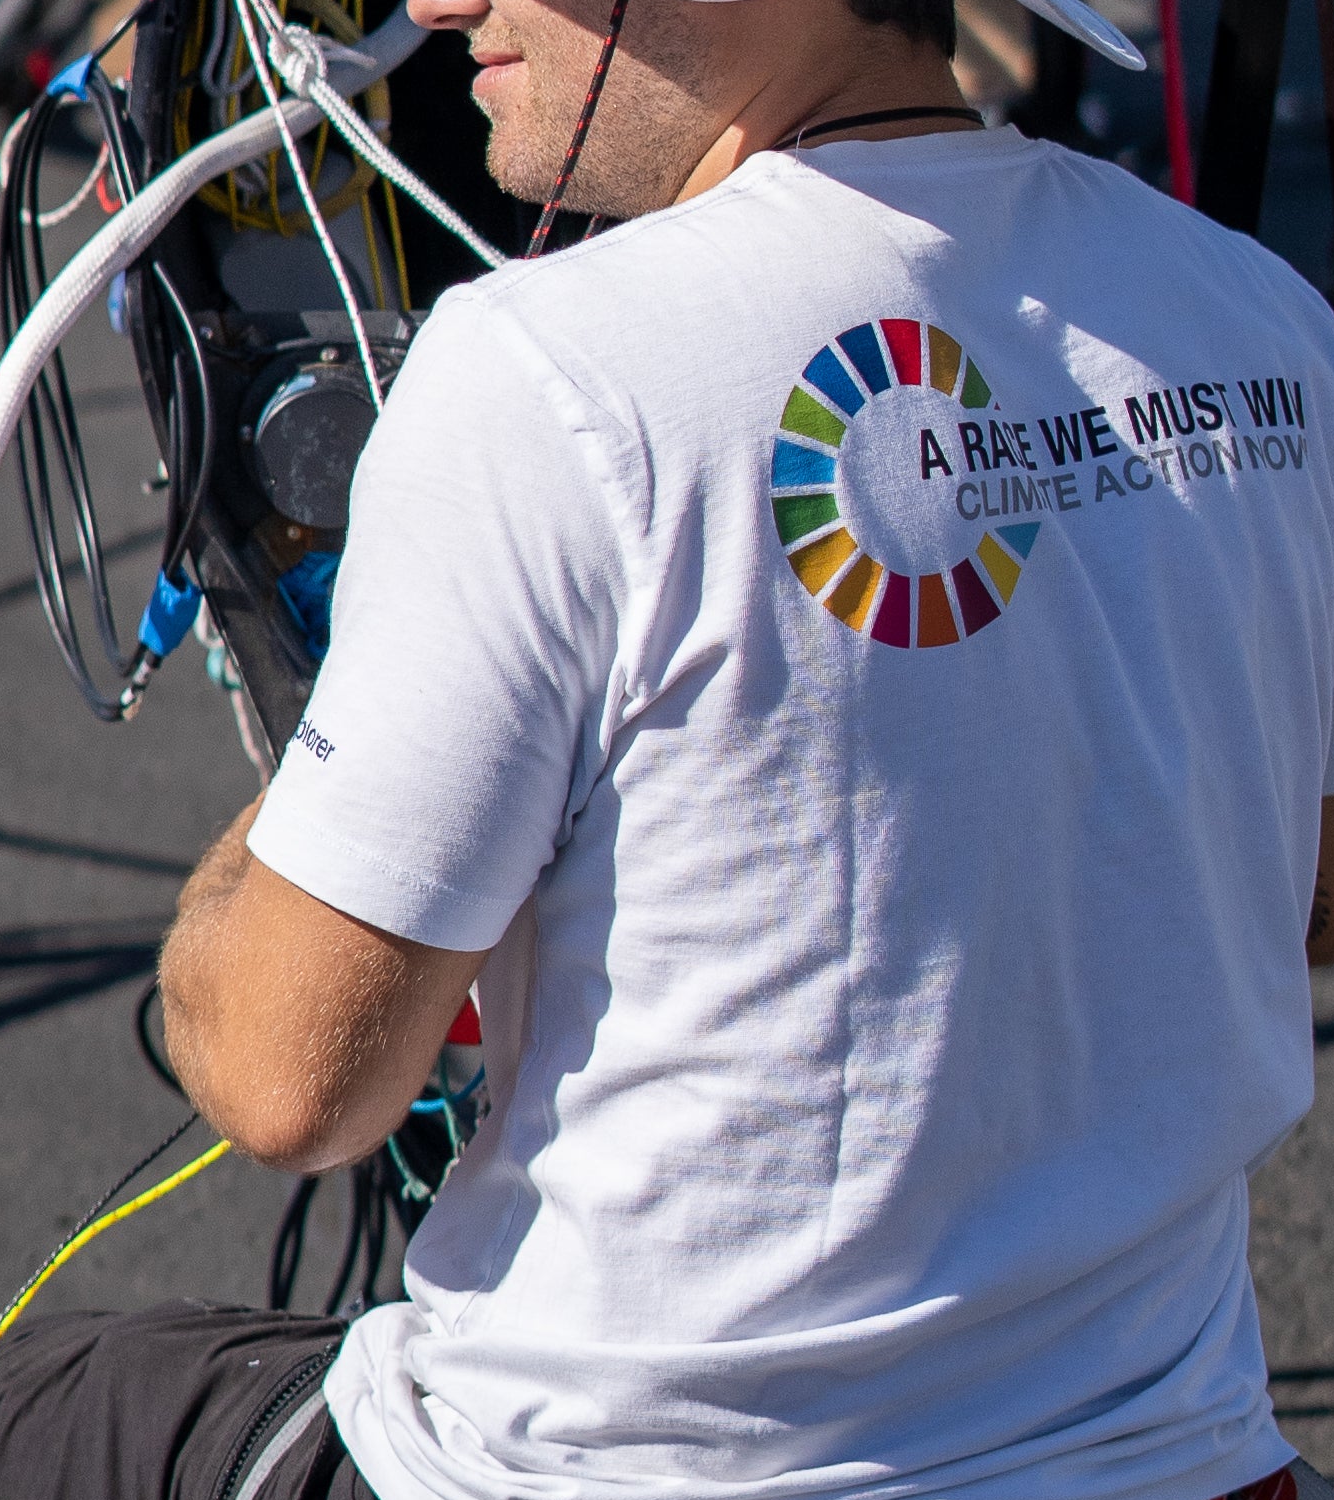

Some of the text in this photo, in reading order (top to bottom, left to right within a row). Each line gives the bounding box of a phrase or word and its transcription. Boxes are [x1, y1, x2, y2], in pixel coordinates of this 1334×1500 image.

[920, 428, 954, 480] A
[1037, 406, 1119, 466] WE
[1123, 382, 1238, 445] MUST
[955, 473, 1083, 521] CLIMTE
[1095, 435, 1244, 503] ACTION
